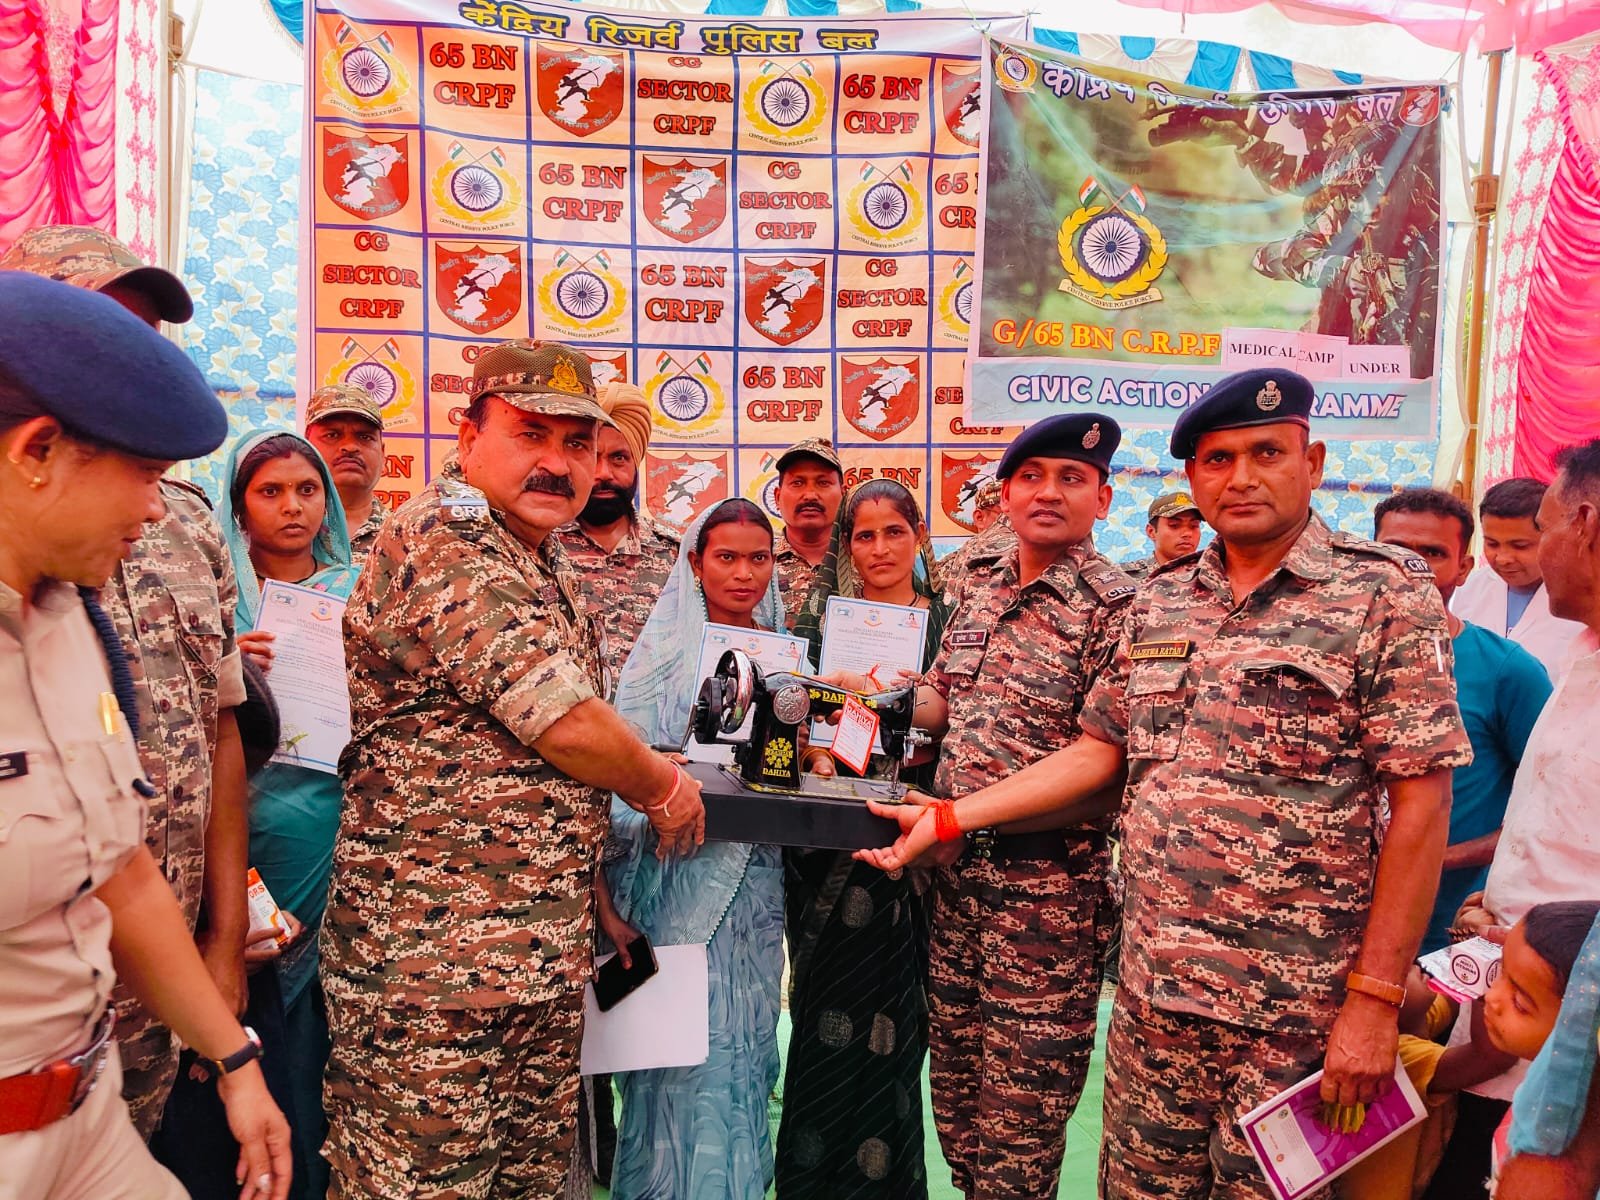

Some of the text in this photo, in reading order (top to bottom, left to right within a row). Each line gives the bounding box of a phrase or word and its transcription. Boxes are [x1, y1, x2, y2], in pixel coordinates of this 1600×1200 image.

[585, 14, 684, 50] रिजर्व
[700, 25, 802, 54] पुलिस
[817, 26, 878, 50] बल
[429, 43, 465, 68] 65
[472, 44, 518, 70] BN
[667, 56, 703, 69] CG
[433, 81, 516, 108] CRPF
[637, 78, 732, 102] SECTOR
[842, 73, 876, 98] 65
[880, 76, 922, 101] BN
[654, 114, 716, 135] CRPF
[844, 110, 920, 134] CRPF
[538, 163, 574, 186] 65
[582, 165, 627, 189] BN
[768, 161, 801, 179] CG
[935, 172, 968, 195] 65
[543, 197, 623, 222] CRPF
[739, 191, 832, 209] SECTOR
[939, 205, 976, 228] CR
[354, 232, 390, 251] CG
[756, 221, 817, 240] CRPF
[323, 264, 421, 289] SECTOR
[641, 264, 676, 286] 65
[683, 265, 728, 288] BN
[865, 259, 898, 277] CG
[339, 298, 404, 319] CRPF
[837, 289, 927, 308] SECTOR
[645, 298, 724, 324] CRPF
[852, 319, 912, 338] CRPF
[992, 319, 1221, 357] G/65 BN C.R.P.F
[1230, 343, 1296, 358] MEDICAL
[1350, 362, 1401, 374] UNDER
[431, 373, 475, 395] SEC
[743, 367, 778, 389] 65
[783, 367, 825, 389] BN
[1008, 375, 1407, 419] CIVIC ACTION RAMME
[747, 400, 822, 423] CRPF
[373, 490, 411, 513] PF
[822, 690, 845, 704] DAH
[762, 767, 791, 778] DAHIYA
[248, 884, 265, 898] ORS
